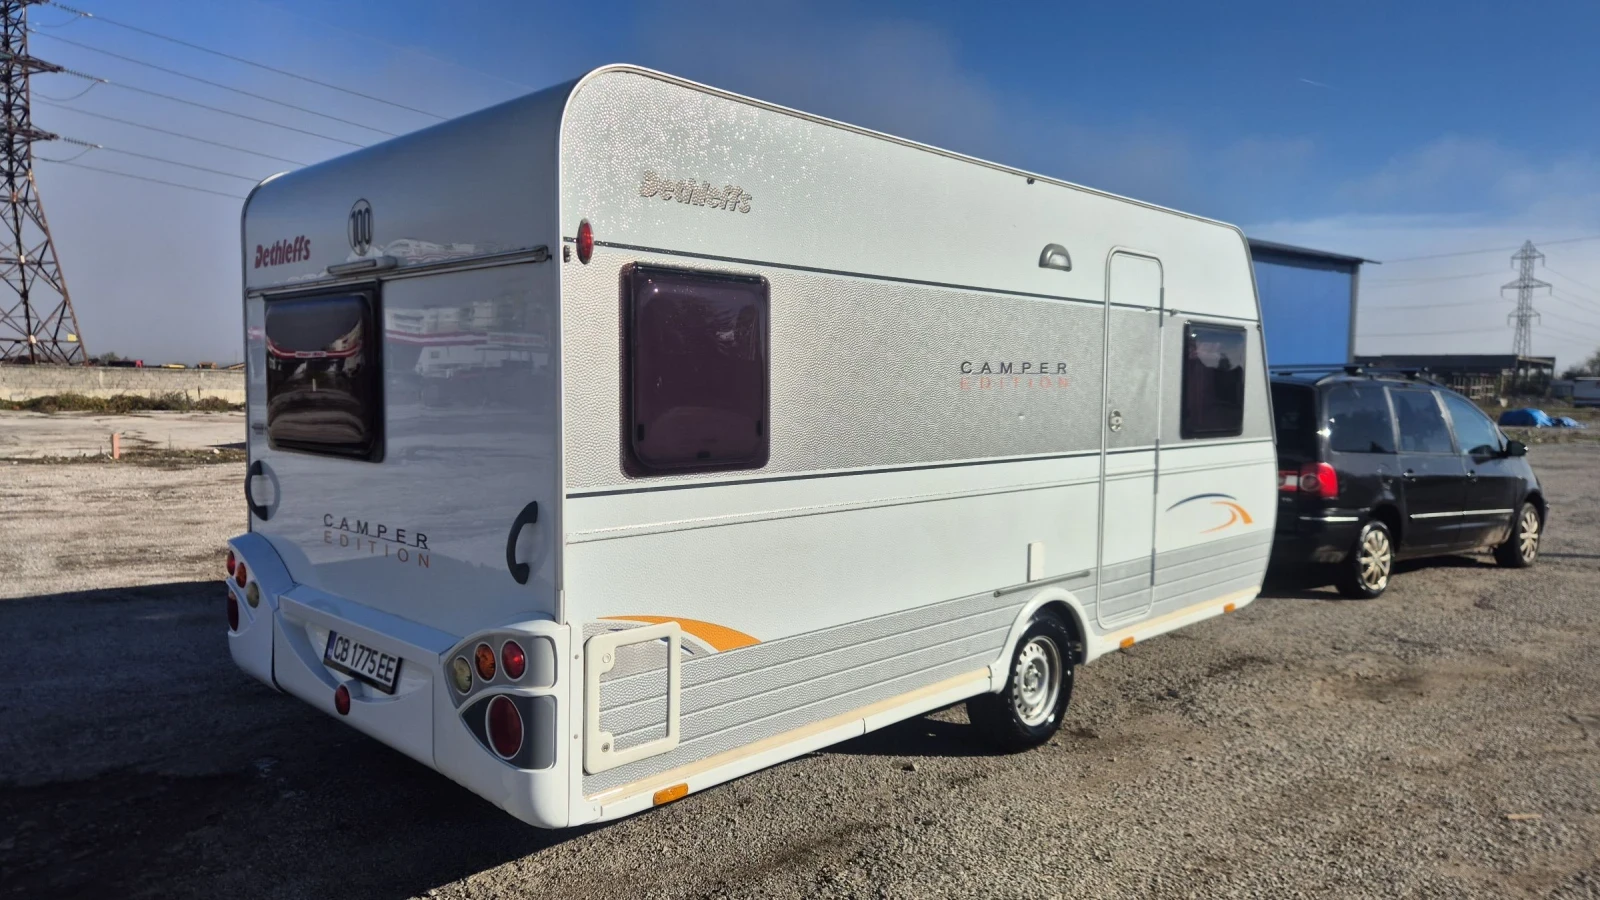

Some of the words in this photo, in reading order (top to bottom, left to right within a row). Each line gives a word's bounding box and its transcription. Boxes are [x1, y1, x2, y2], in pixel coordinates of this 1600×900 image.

[640, 169, 752, 213] Dethleffs
[254, 235, 311, 269] Dethleffs
[960, 361, 1067, 374] CAMPER
[960, 376, 1069, 390] EDITION
[323, 513, 430, 550] CAMPER
[323, 530, 429, 568] EDITION
